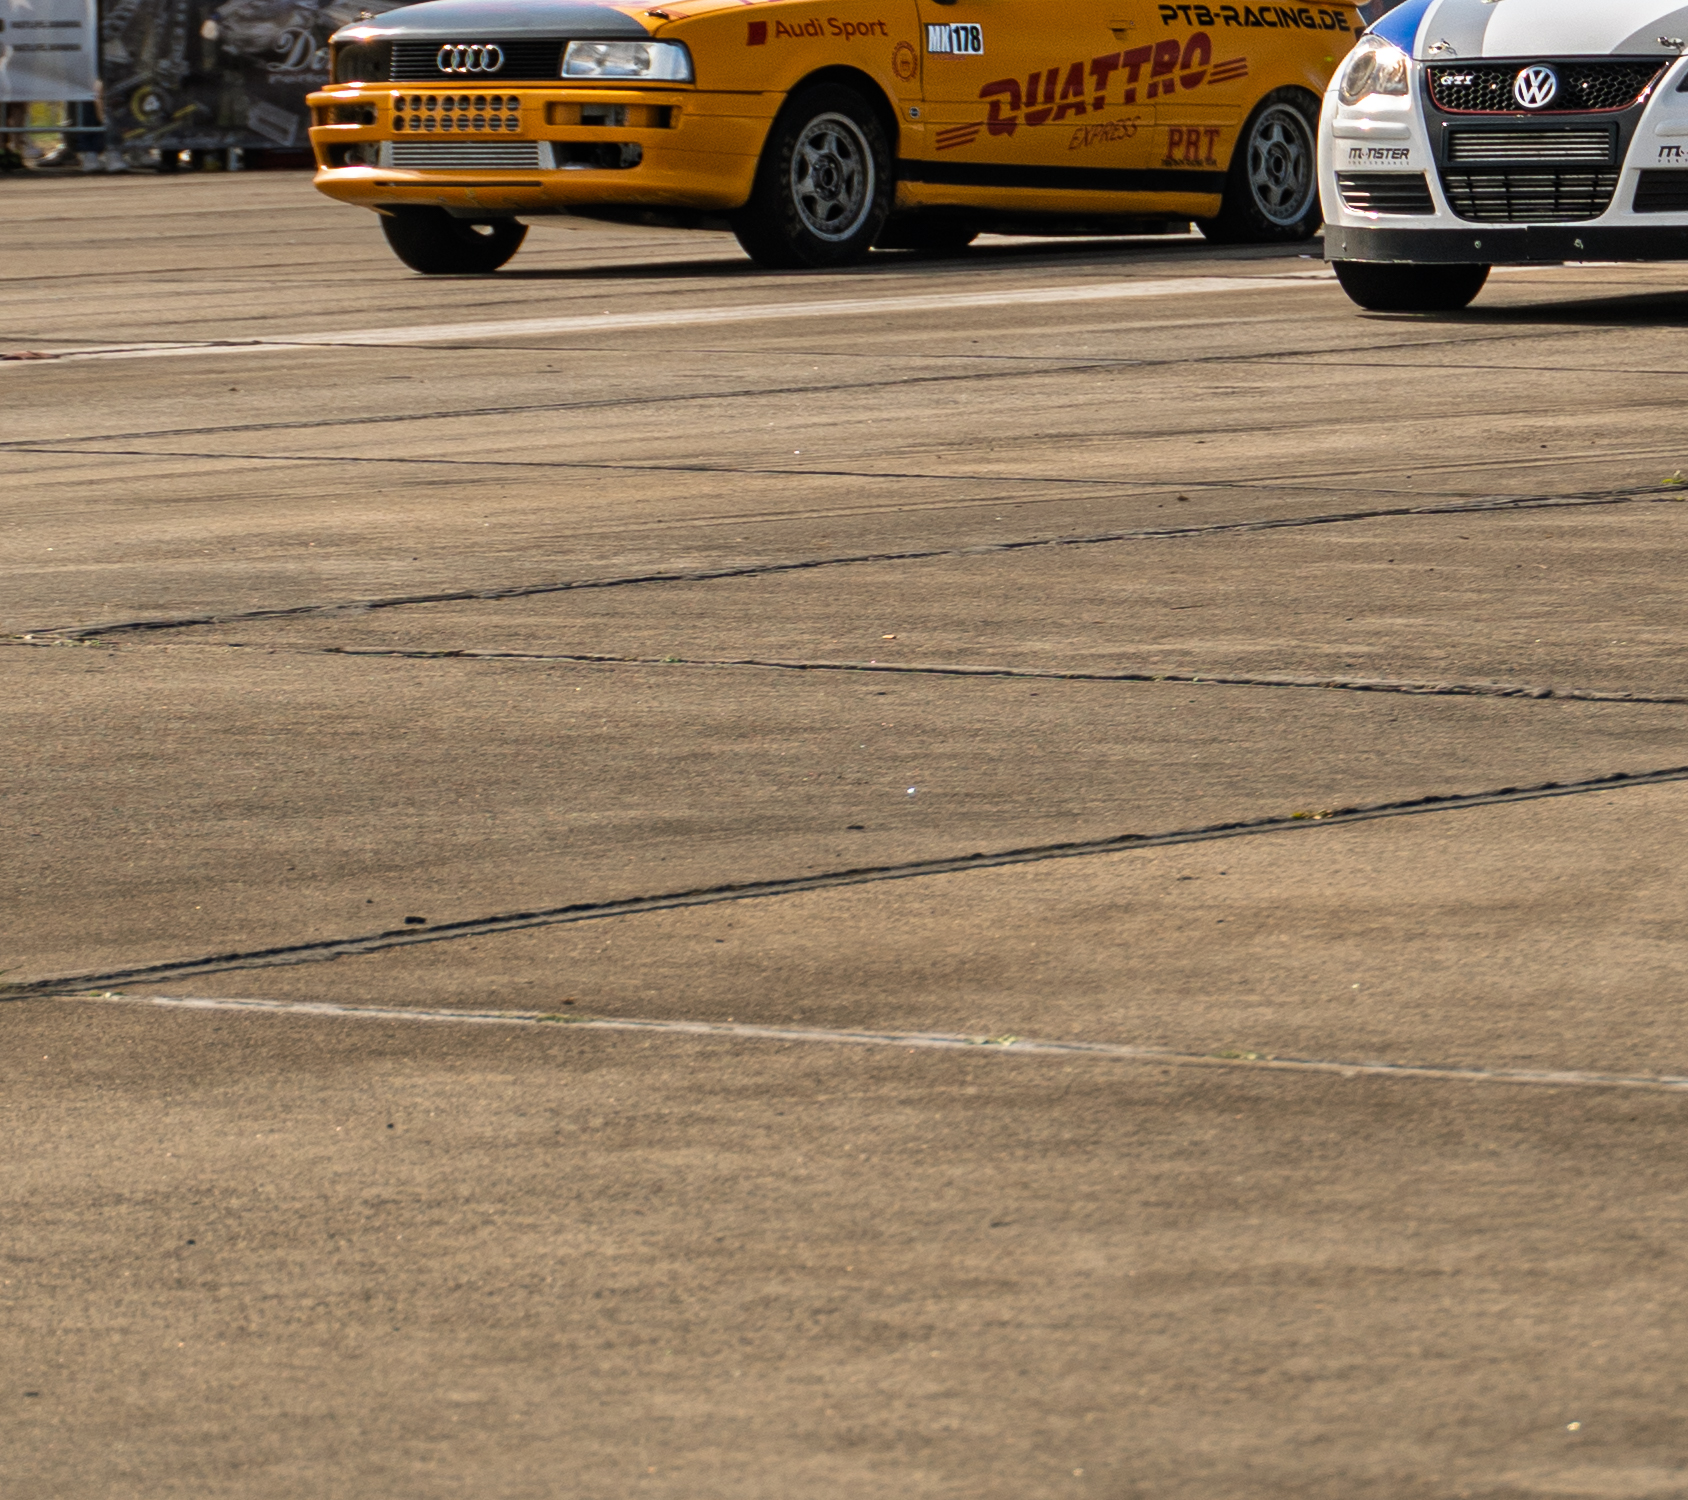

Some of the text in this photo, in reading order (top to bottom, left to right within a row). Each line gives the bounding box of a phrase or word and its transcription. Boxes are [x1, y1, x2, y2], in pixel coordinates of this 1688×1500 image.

[775, 17, 888, 41] Audi Sport
[1157, 4, 1350, 32] PTB-RACING.DE
[952, 25, 981, 53] 178
[979, 31, 1212, 137] QUATTRO
[1440, 75, 1473, 86] GTI
[1068, 116, 1141, 150] EXPRESS
